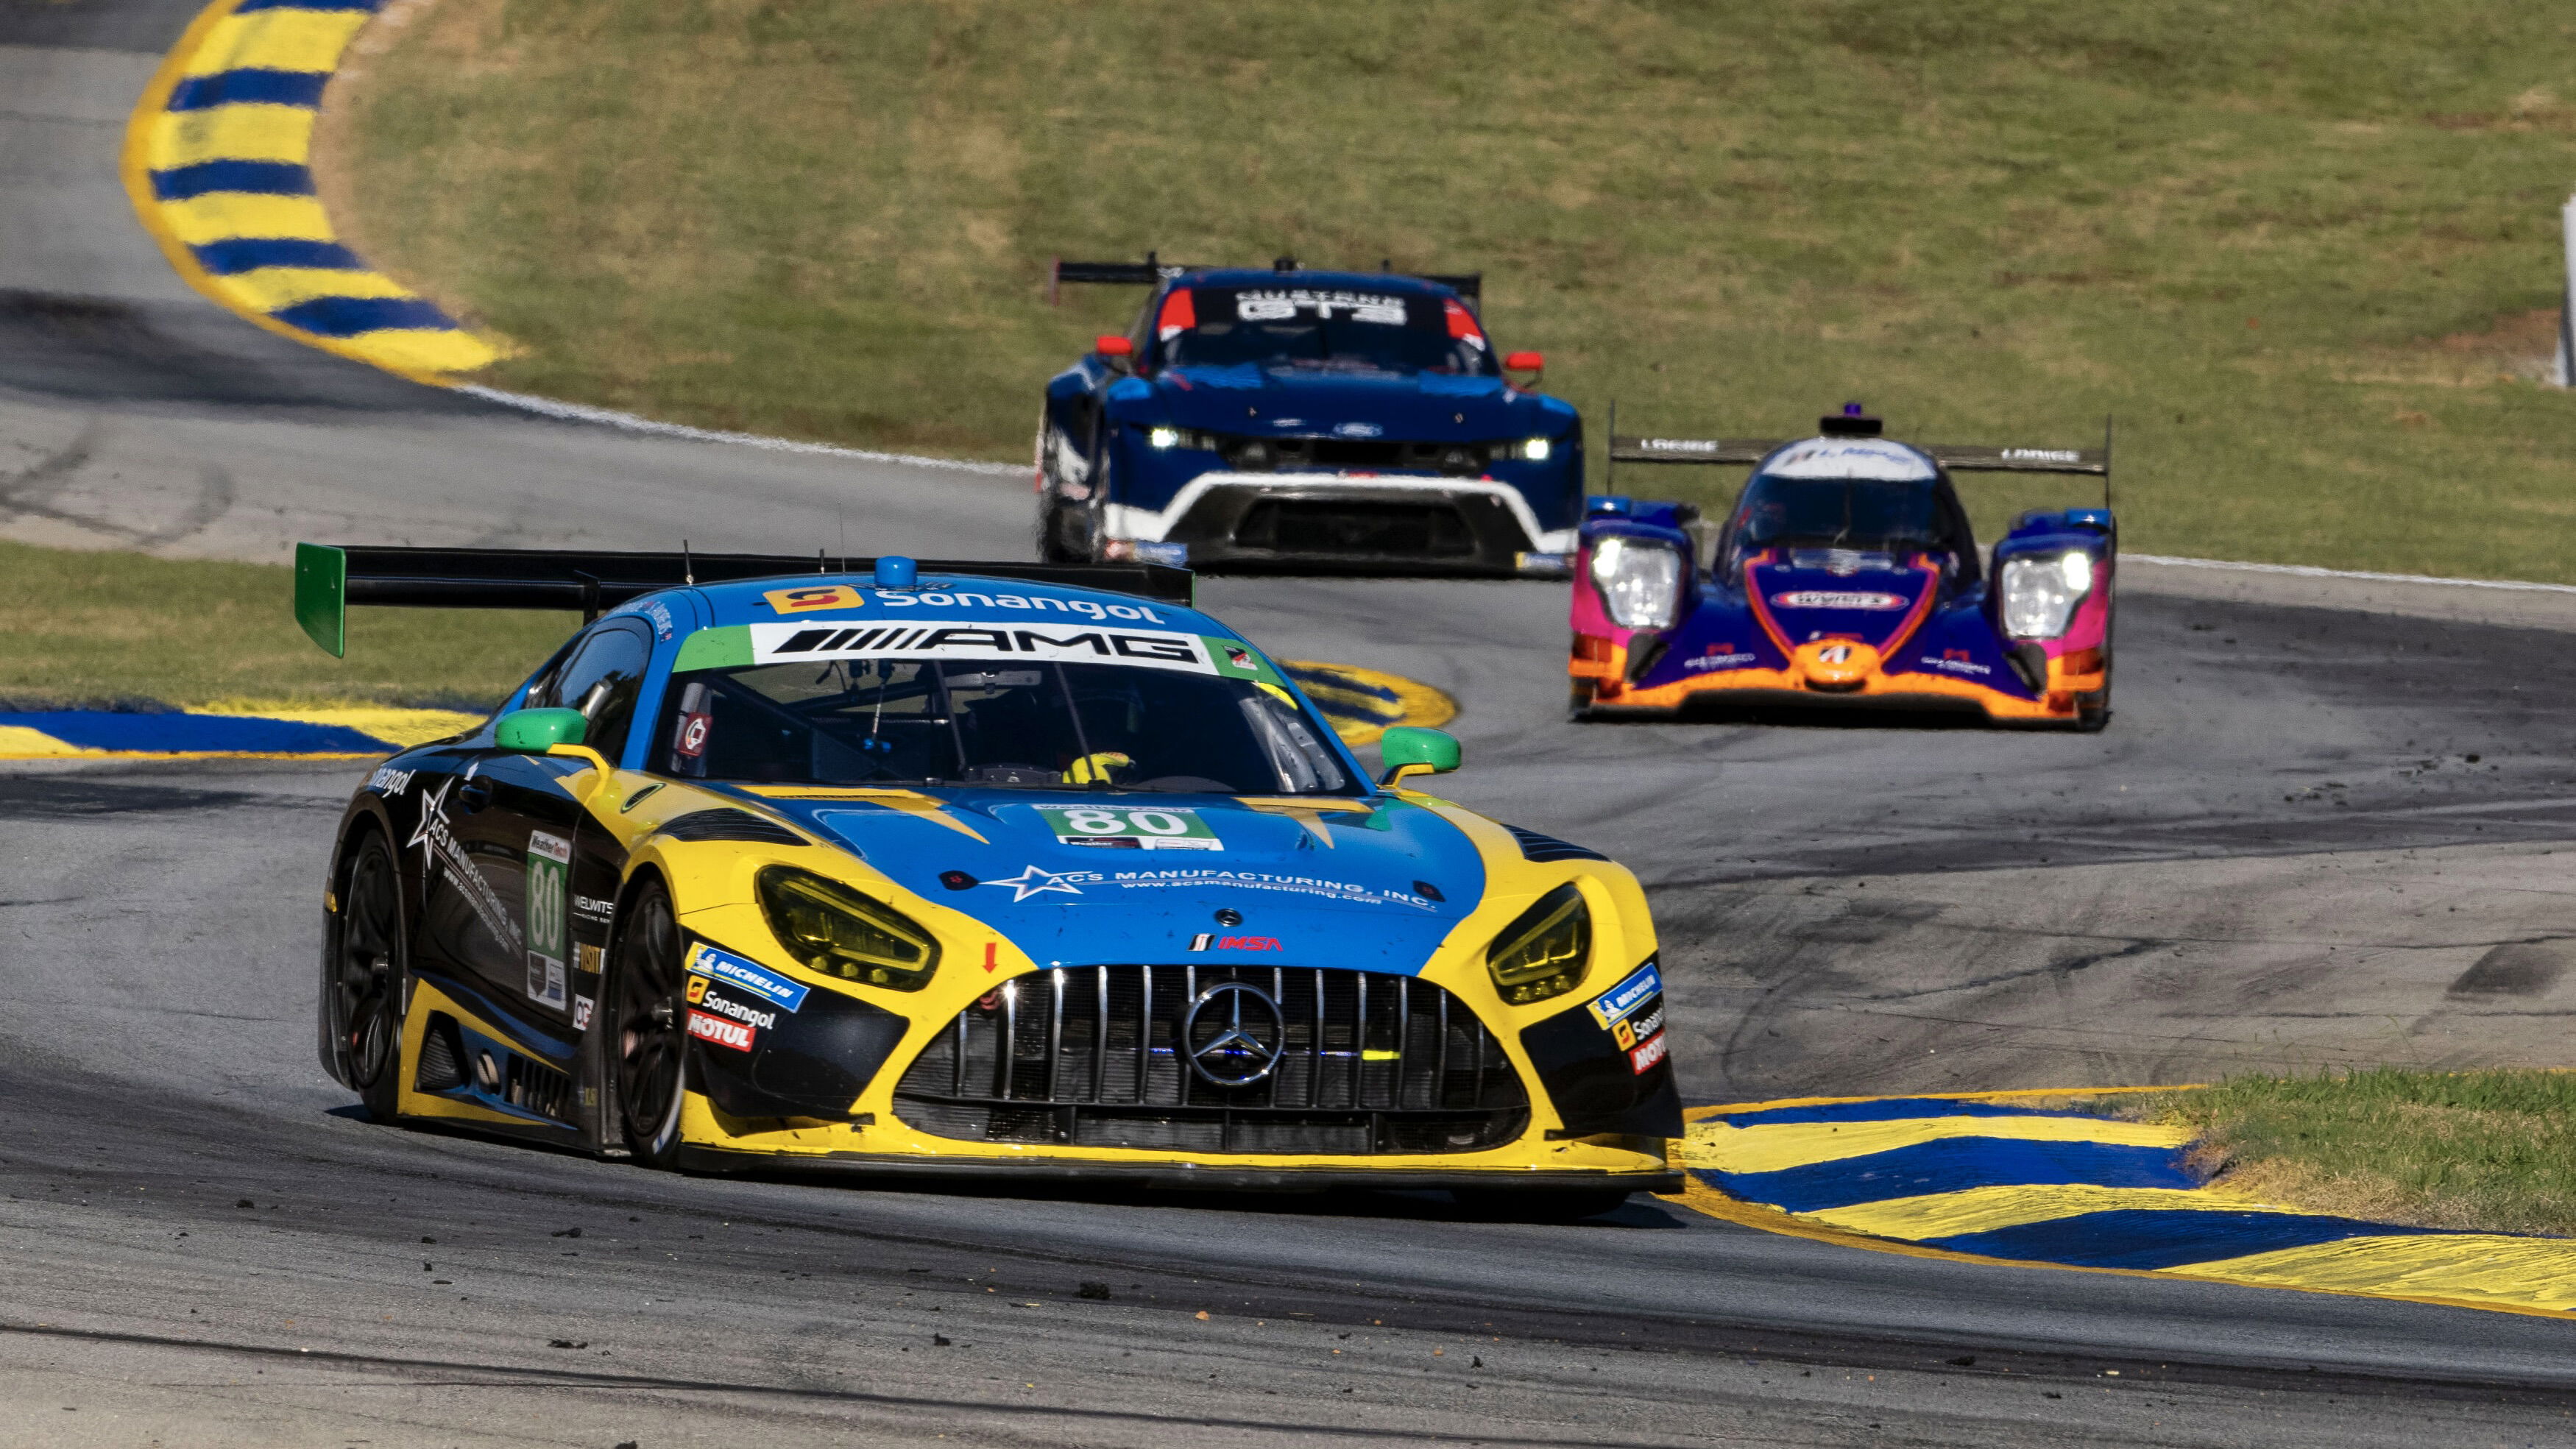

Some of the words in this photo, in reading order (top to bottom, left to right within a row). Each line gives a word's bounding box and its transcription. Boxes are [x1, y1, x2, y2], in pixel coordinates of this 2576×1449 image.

[874, 590, 1165, 625] Sonangol
[918, 628, 1199, 665] AMG
[429, 818, 449, 846] ACS
[1064, 809, 1188, 835] 80
[531, 861, 559, 951] 80
[1046, 873, 1104, 885] ACS
[1114, 869, 1373, 895] MANUFACTURING,
[1383, 889, 1437, 910] INC.
[1121, 880, 1382, 904] www.acsmanufacturing.com
[1217, 935, 1284, 952] IMSA
[715, 960, 795, 999] MICHELIN
[701, 991, 776, 1030] Sonangol
[687, 1013, 750, 1048] MOTUL
